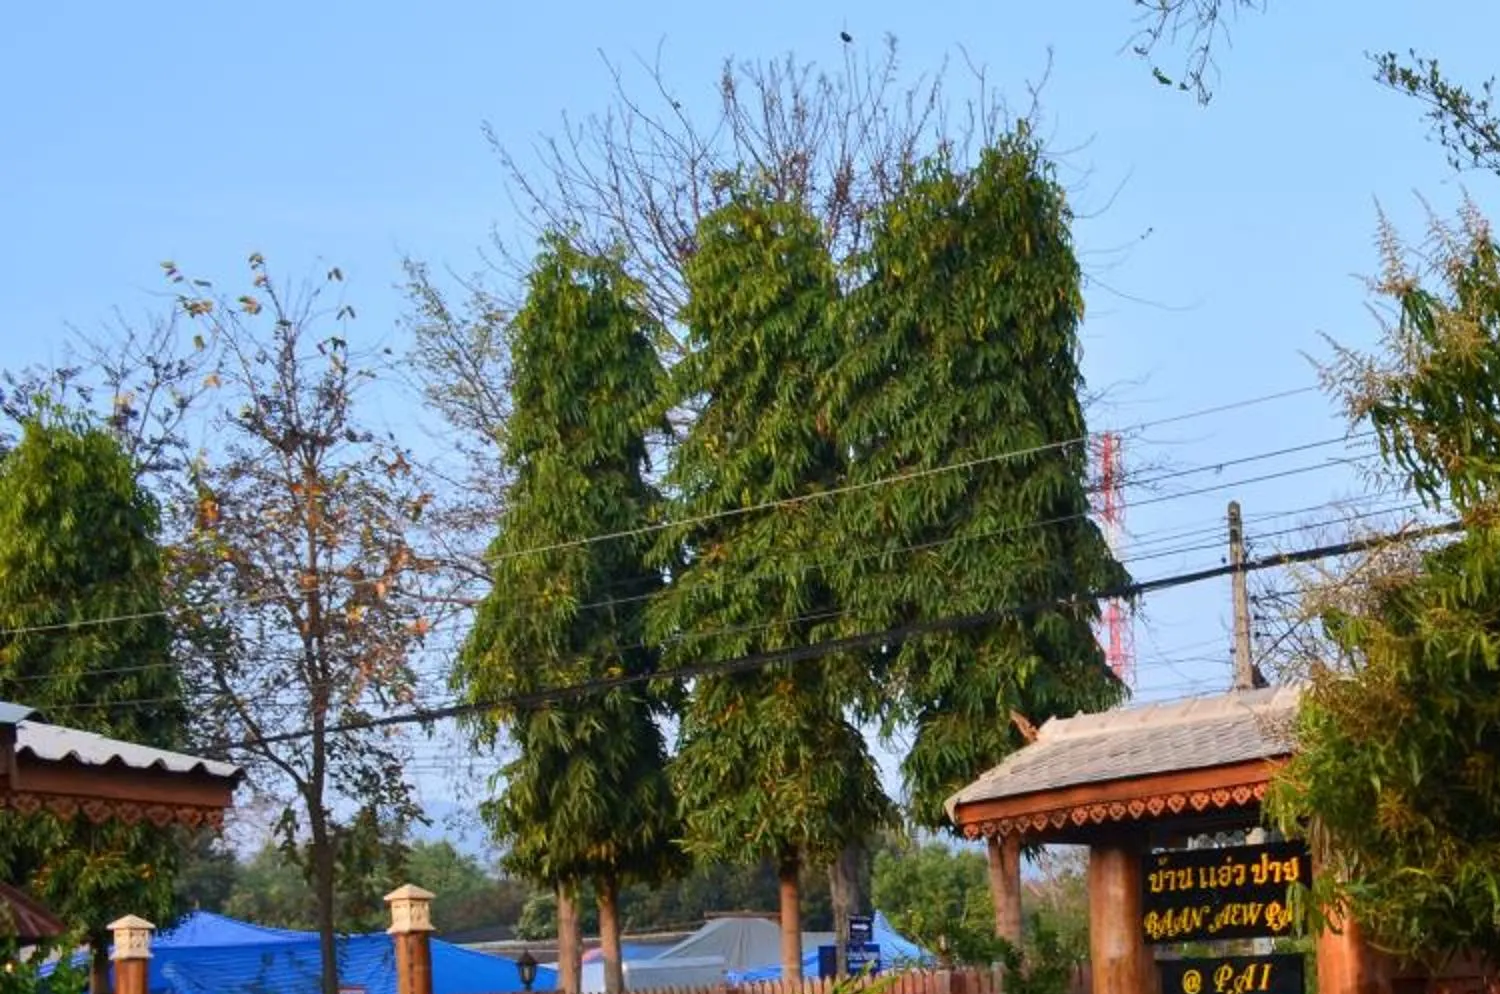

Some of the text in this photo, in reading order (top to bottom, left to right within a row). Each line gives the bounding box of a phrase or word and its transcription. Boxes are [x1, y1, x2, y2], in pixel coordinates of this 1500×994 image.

[1148, 852, 1299, 893] บ้าน แอ่ว ปาย
[1144, 905, 1210, 939] BAAN
[1208, 902, 1264, 933] AEW
